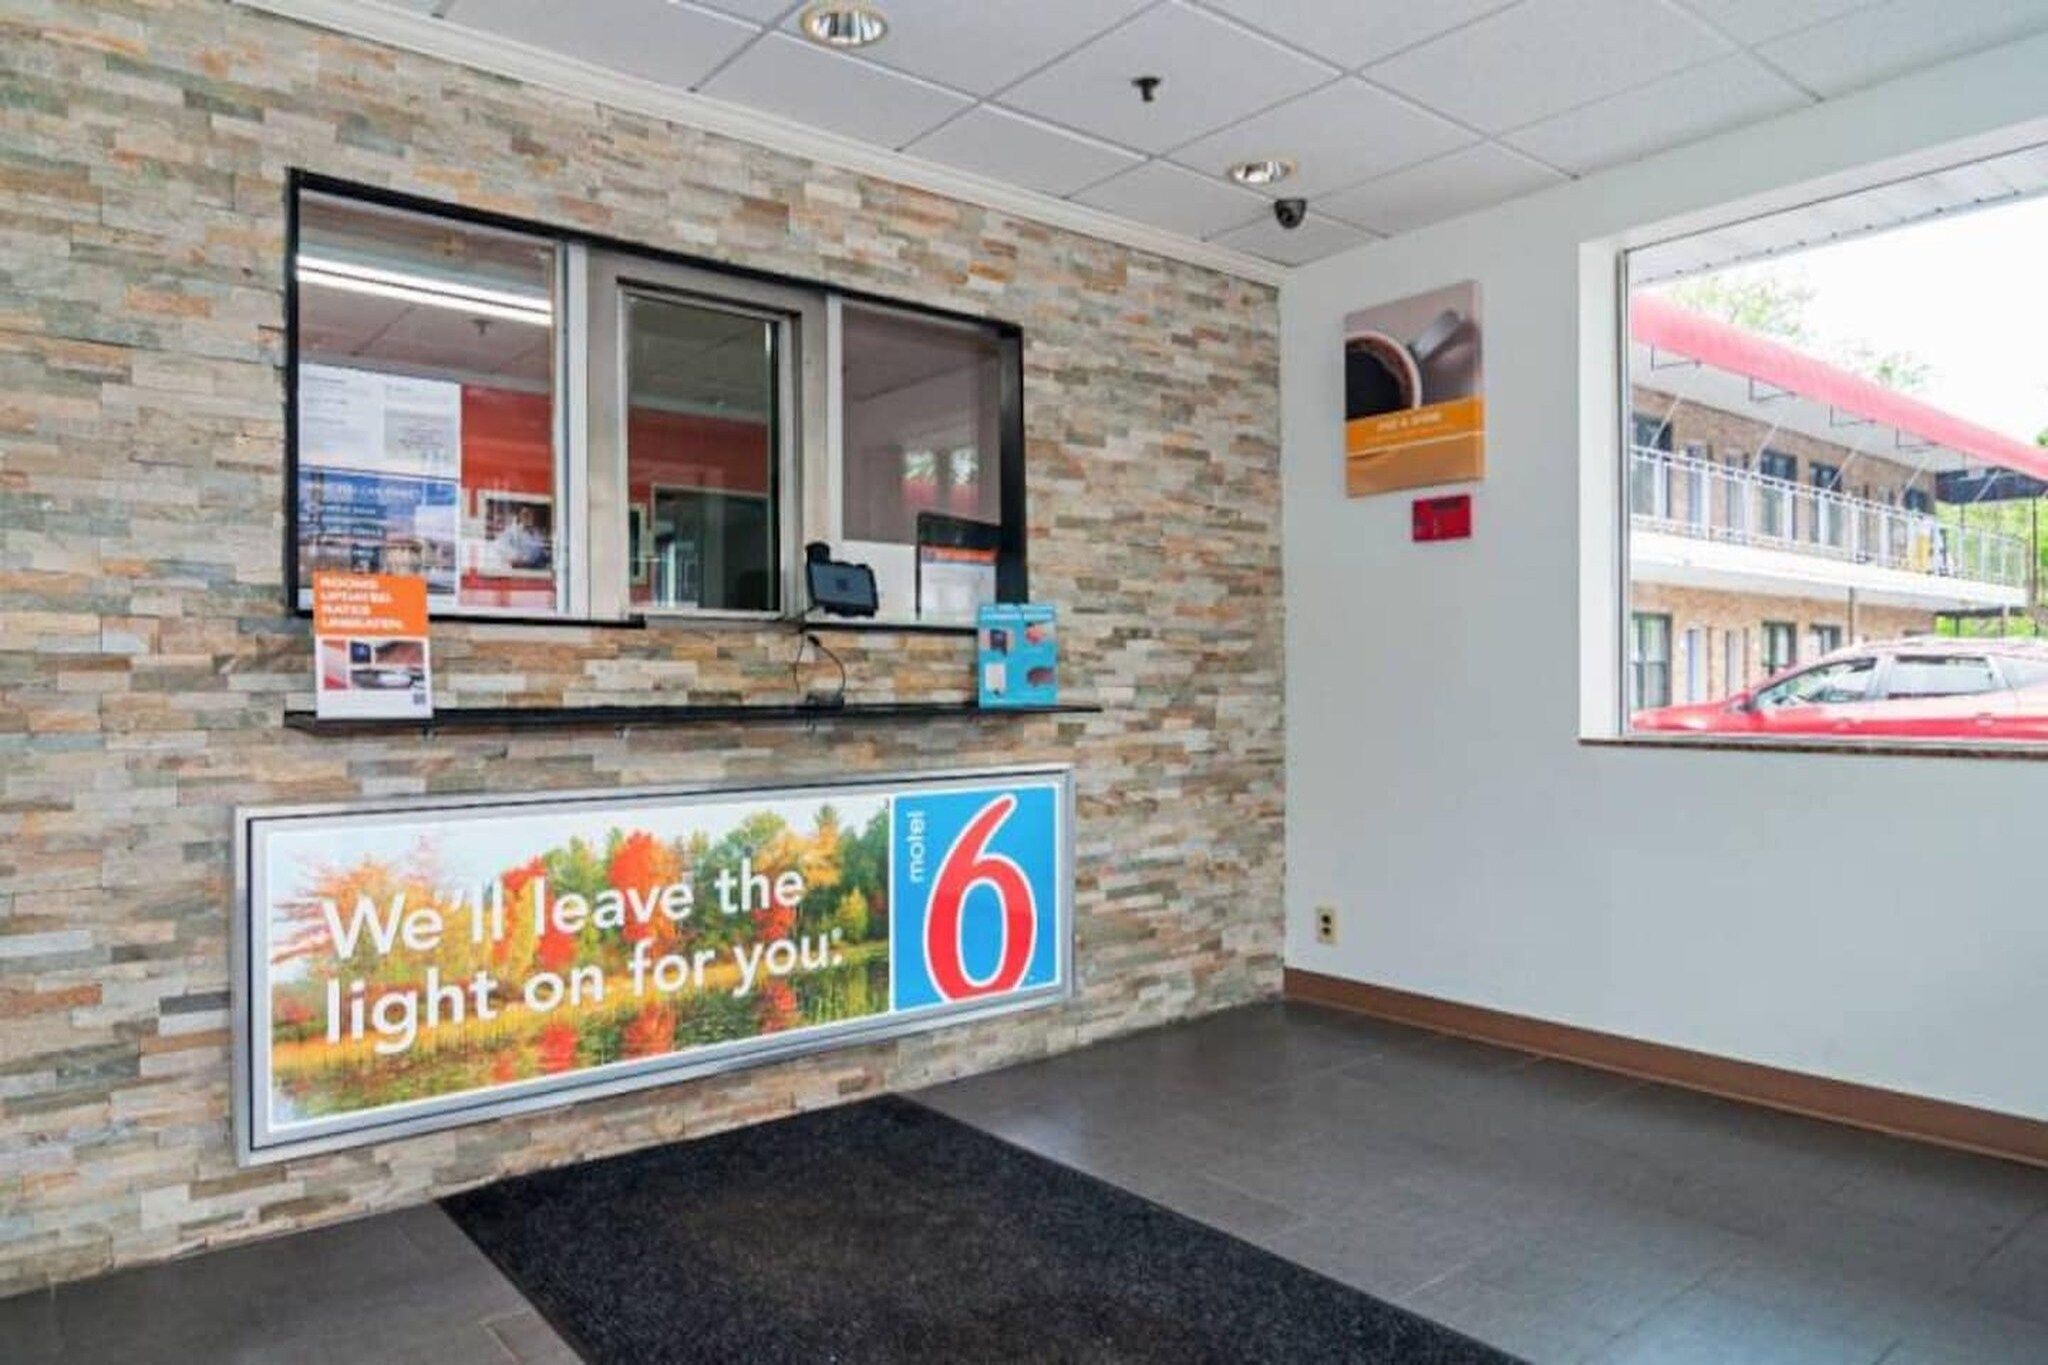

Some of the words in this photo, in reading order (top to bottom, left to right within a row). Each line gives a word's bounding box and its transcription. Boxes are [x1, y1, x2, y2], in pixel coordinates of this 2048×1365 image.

[907, 809, 926, 884] motel
[533, 875, 695, 936] leave
[715, 857, 804, 915] the
[923, 793, 1037, 1003] 6
[326, 966, 498, 1055] light
[524, 964, 604, 1003] on
[628, 937, 716, 998] for
